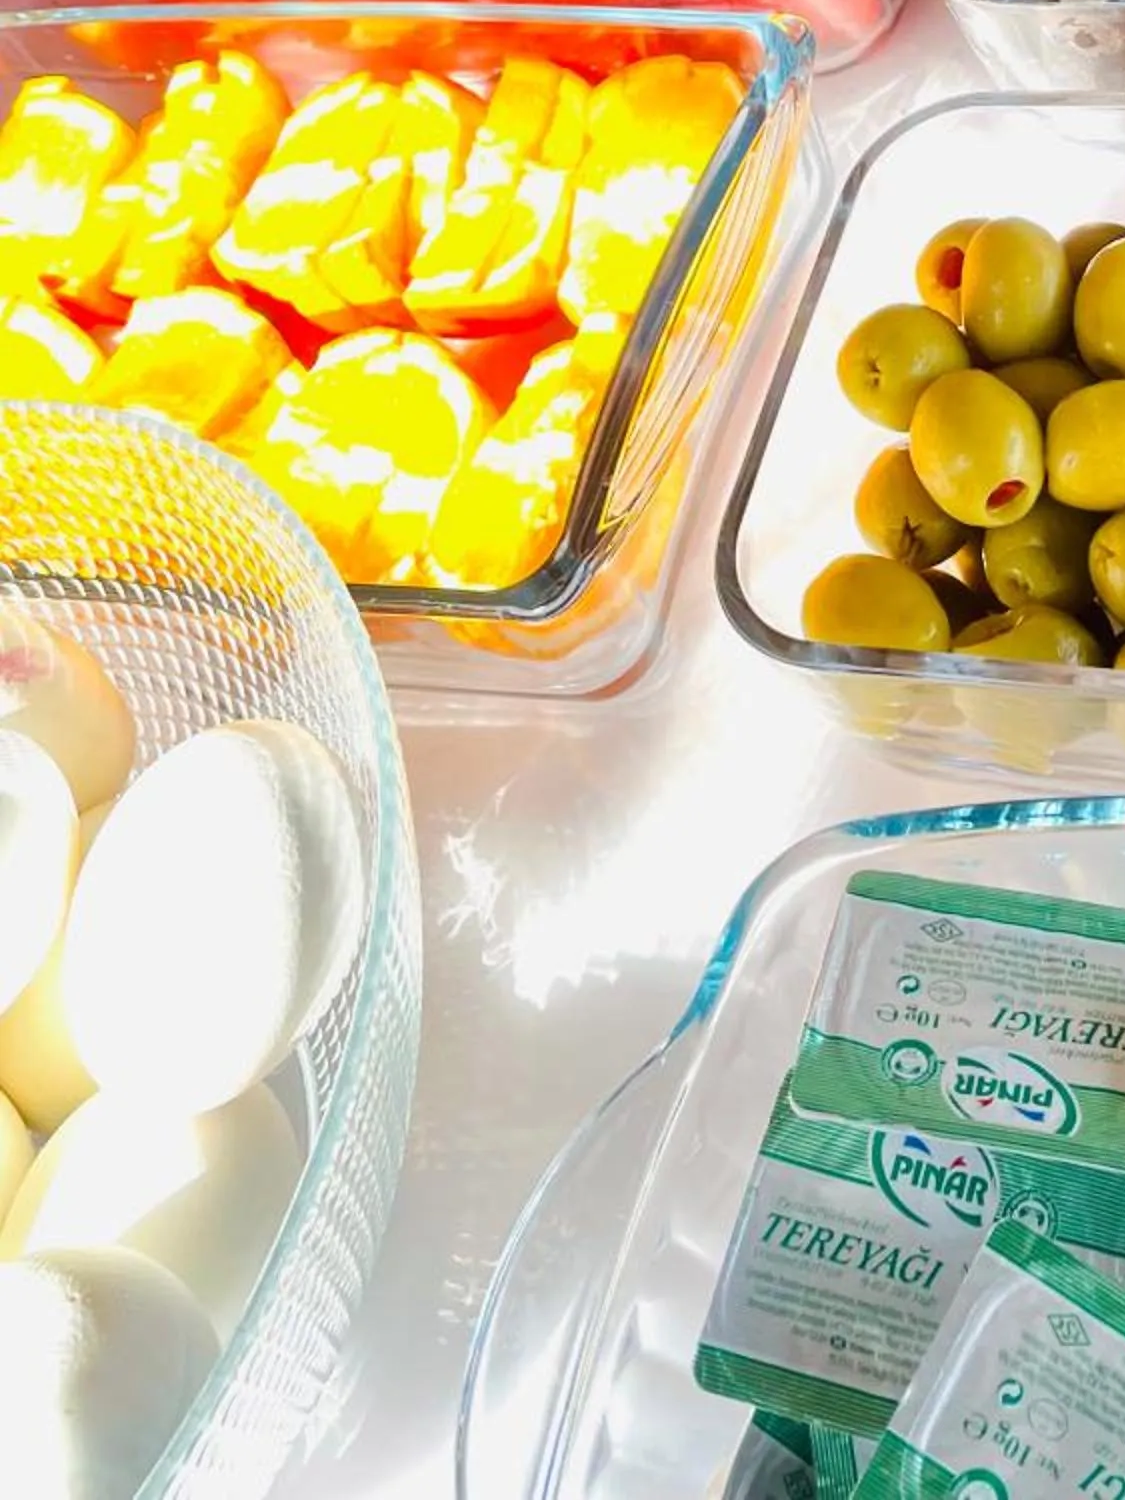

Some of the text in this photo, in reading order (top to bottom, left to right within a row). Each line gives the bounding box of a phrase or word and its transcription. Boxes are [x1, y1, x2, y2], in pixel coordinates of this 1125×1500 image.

[953, 1073, 1053, 1108] PINAR
[890, 1153, 989, 1207] PINAR
[758, 1211, 945, 1289] TEREYAĞI
